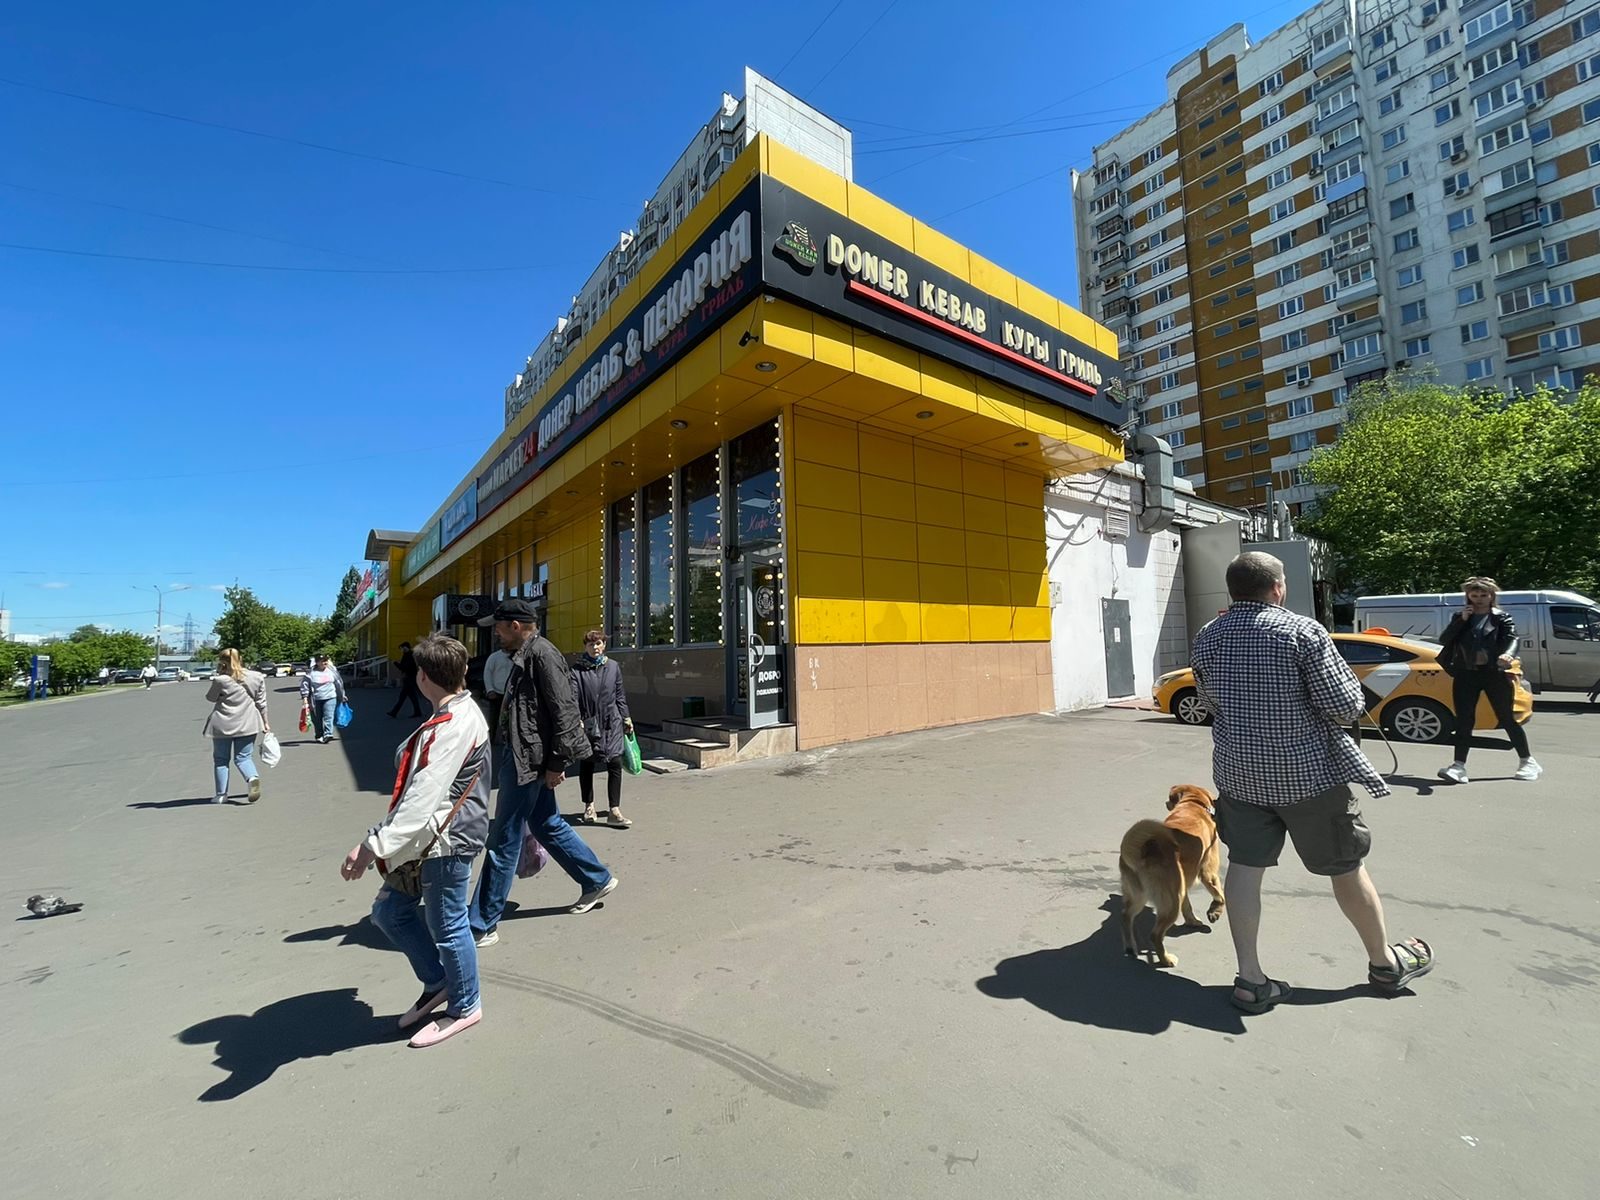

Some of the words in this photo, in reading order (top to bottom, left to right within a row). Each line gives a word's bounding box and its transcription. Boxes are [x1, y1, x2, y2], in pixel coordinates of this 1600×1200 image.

[537, 390, 574, 452] ДОНЕР
[575, 341, 624, 416] КЕБАБ
[625, 328, 642, 367] &
[643, 209, 752, 352] ПЕКАРНЯ
[700, 276, 745, 322] ГРИЛЬ
[827, 232, 910, 300] DONER
[919, 279, 987, 334] KEBAB
[1001, 320, 1050, 363] КУРЫ
[1057, 348, 1103, 387] ГРИЛЬ
[758, 670, 781, 683] ДОБРО
